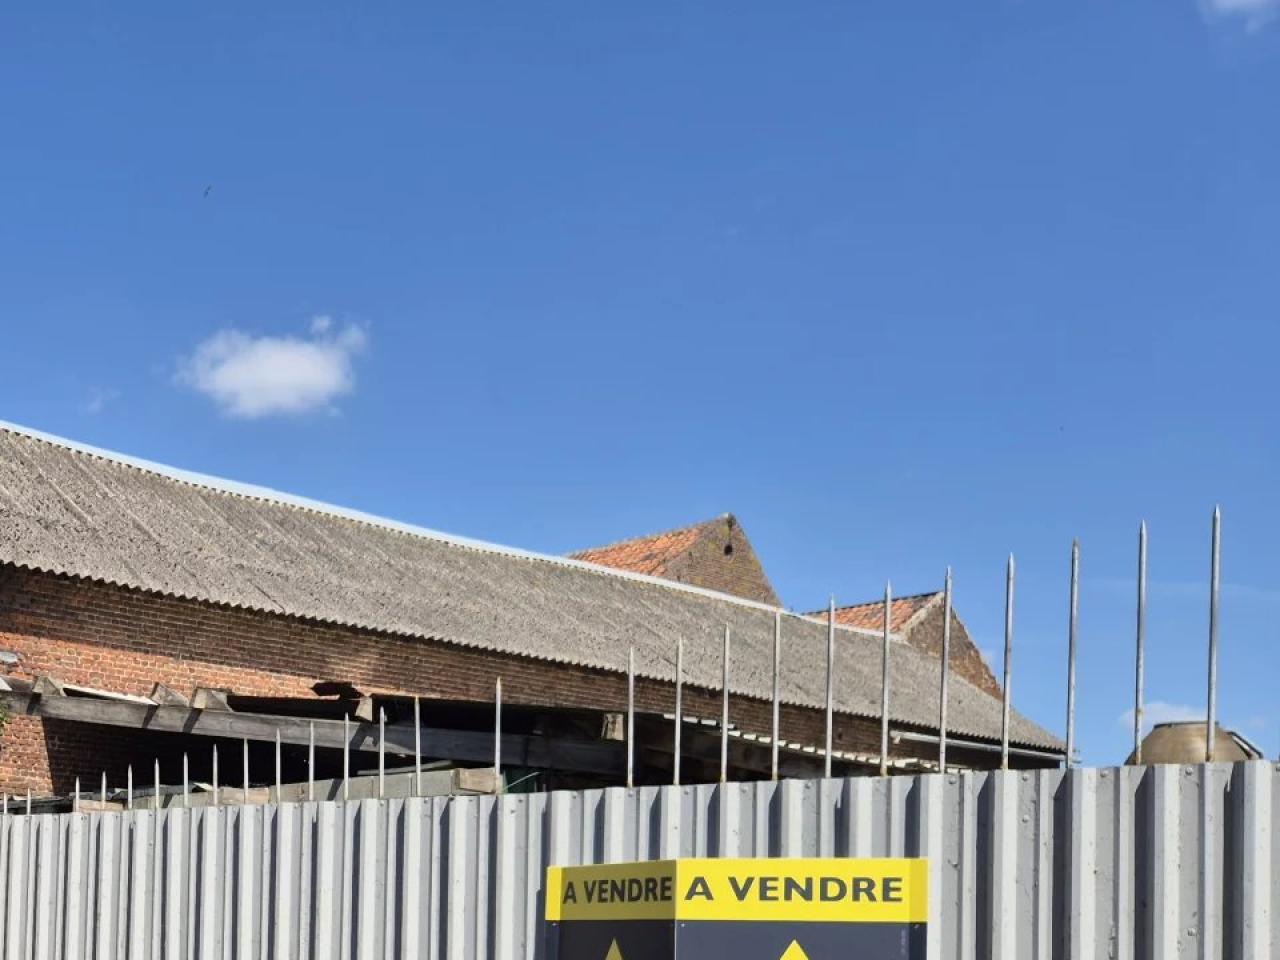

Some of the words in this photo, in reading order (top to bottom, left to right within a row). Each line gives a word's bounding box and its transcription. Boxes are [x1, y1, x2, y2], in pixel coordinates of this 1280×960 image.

[562, 881, 577, 904] A
[584, 876, 672, 904] VENDRE
[684, 876, 714, 901] A
[728, 876, 903, 902] VENDRE
